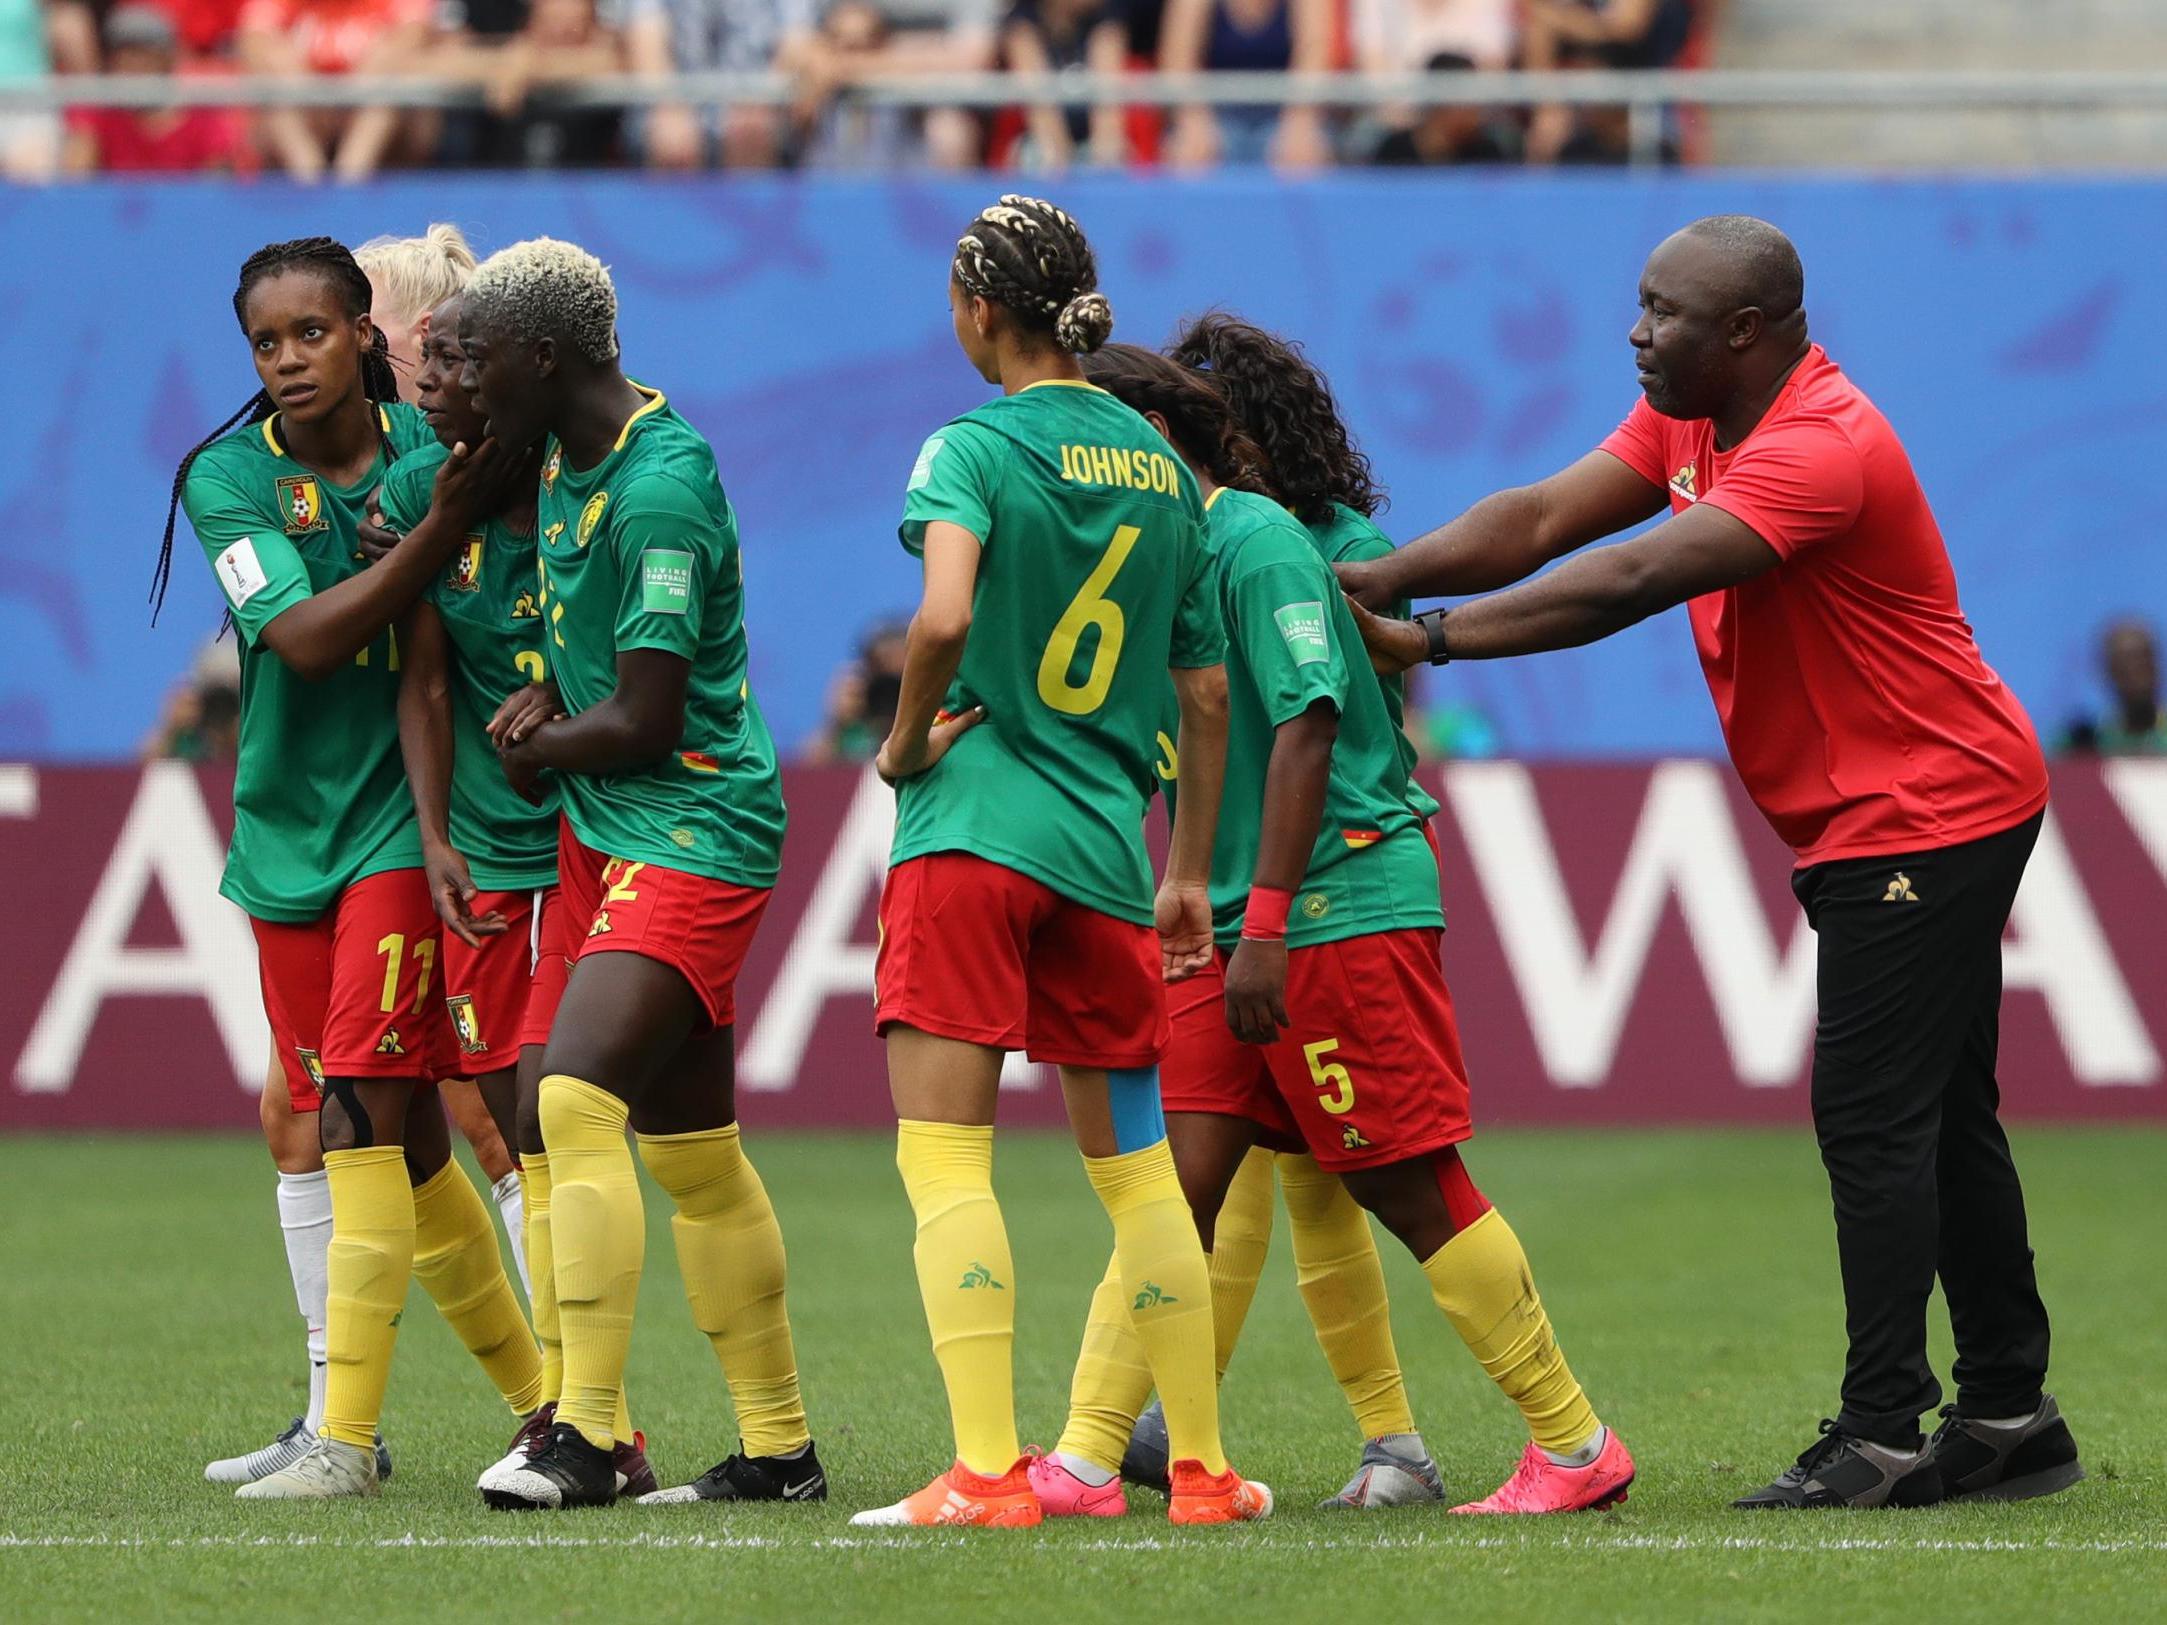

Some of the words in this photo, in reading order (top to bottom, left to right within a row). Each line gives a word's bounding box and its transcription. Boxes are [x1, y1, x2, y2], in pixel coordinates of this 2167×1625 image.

[1060, 444, 1179, 499] JOHNSON
[646, 566, 688, 576] LIVING
[1037, 524, 1142, 715] 6
[377, 932, 437, 1015] 11
[1303, 1037, 1355, 1115] 5
